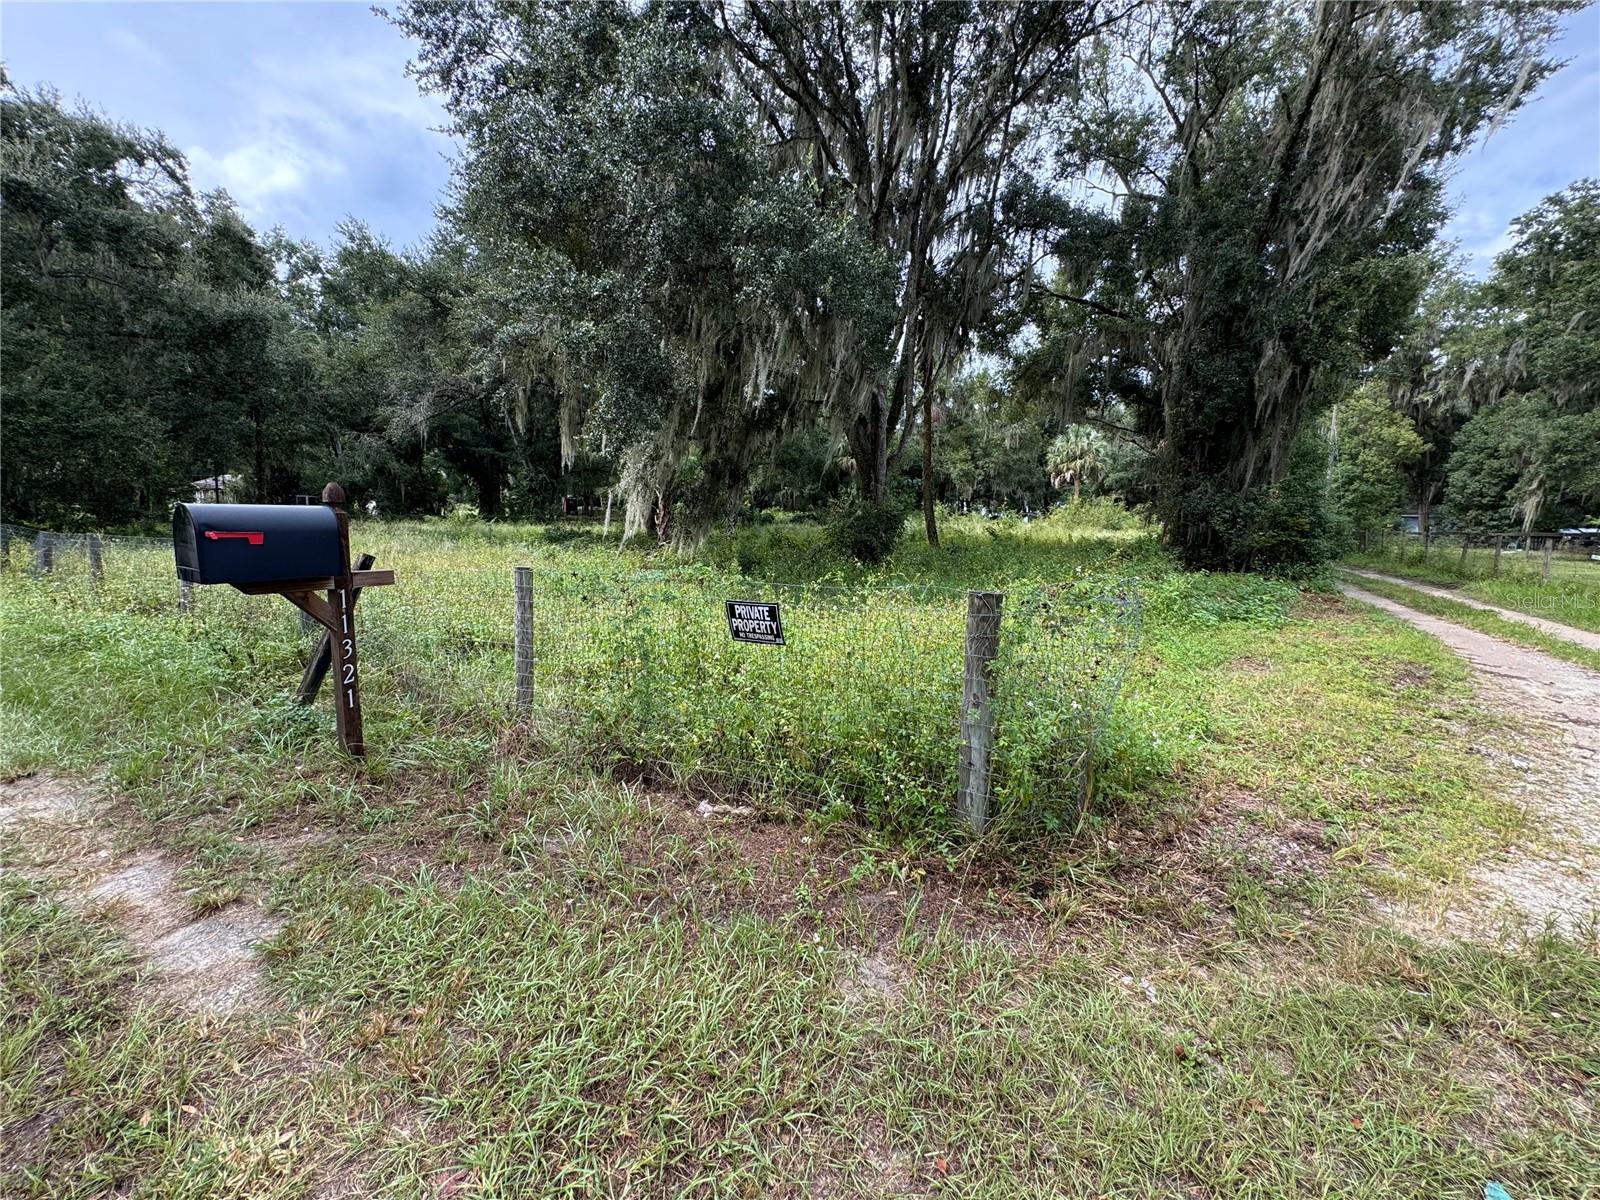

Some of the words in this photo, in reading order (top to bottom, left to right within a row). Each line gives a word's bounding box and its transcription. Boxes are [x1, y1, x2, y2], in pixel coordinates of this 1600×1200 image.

[734, 605, 771, 620] PRIVATE
[732, 618, 777, 634] PROPERTY
[339, 588, 355, 708] 11321
